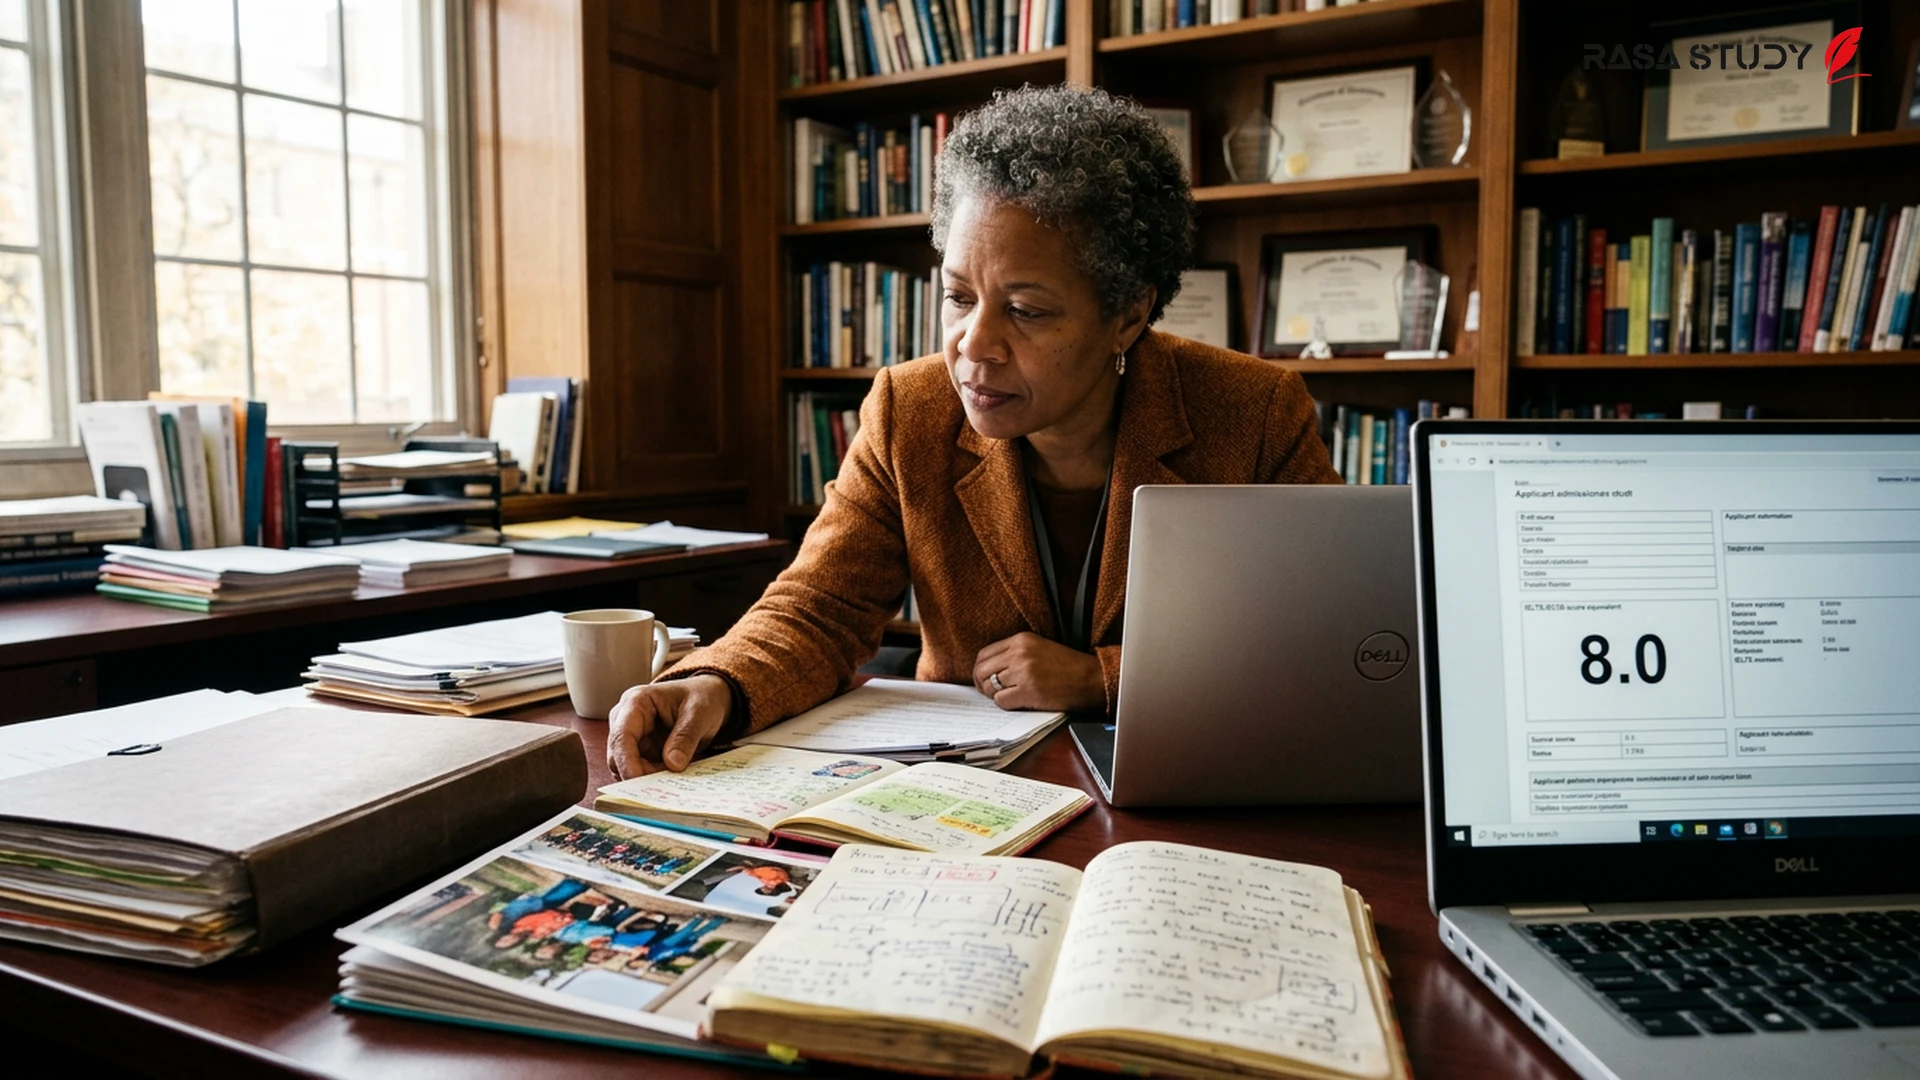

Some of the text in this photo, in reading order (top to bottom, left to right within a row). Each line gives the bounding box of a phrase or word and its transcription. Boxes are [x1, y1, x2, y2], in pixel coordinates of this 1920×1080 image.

[1361, 649, 1404, 663] DELL
[1581, 633, 1667, 685] 8.0
[1775, 857, 1820, 873] DELL
